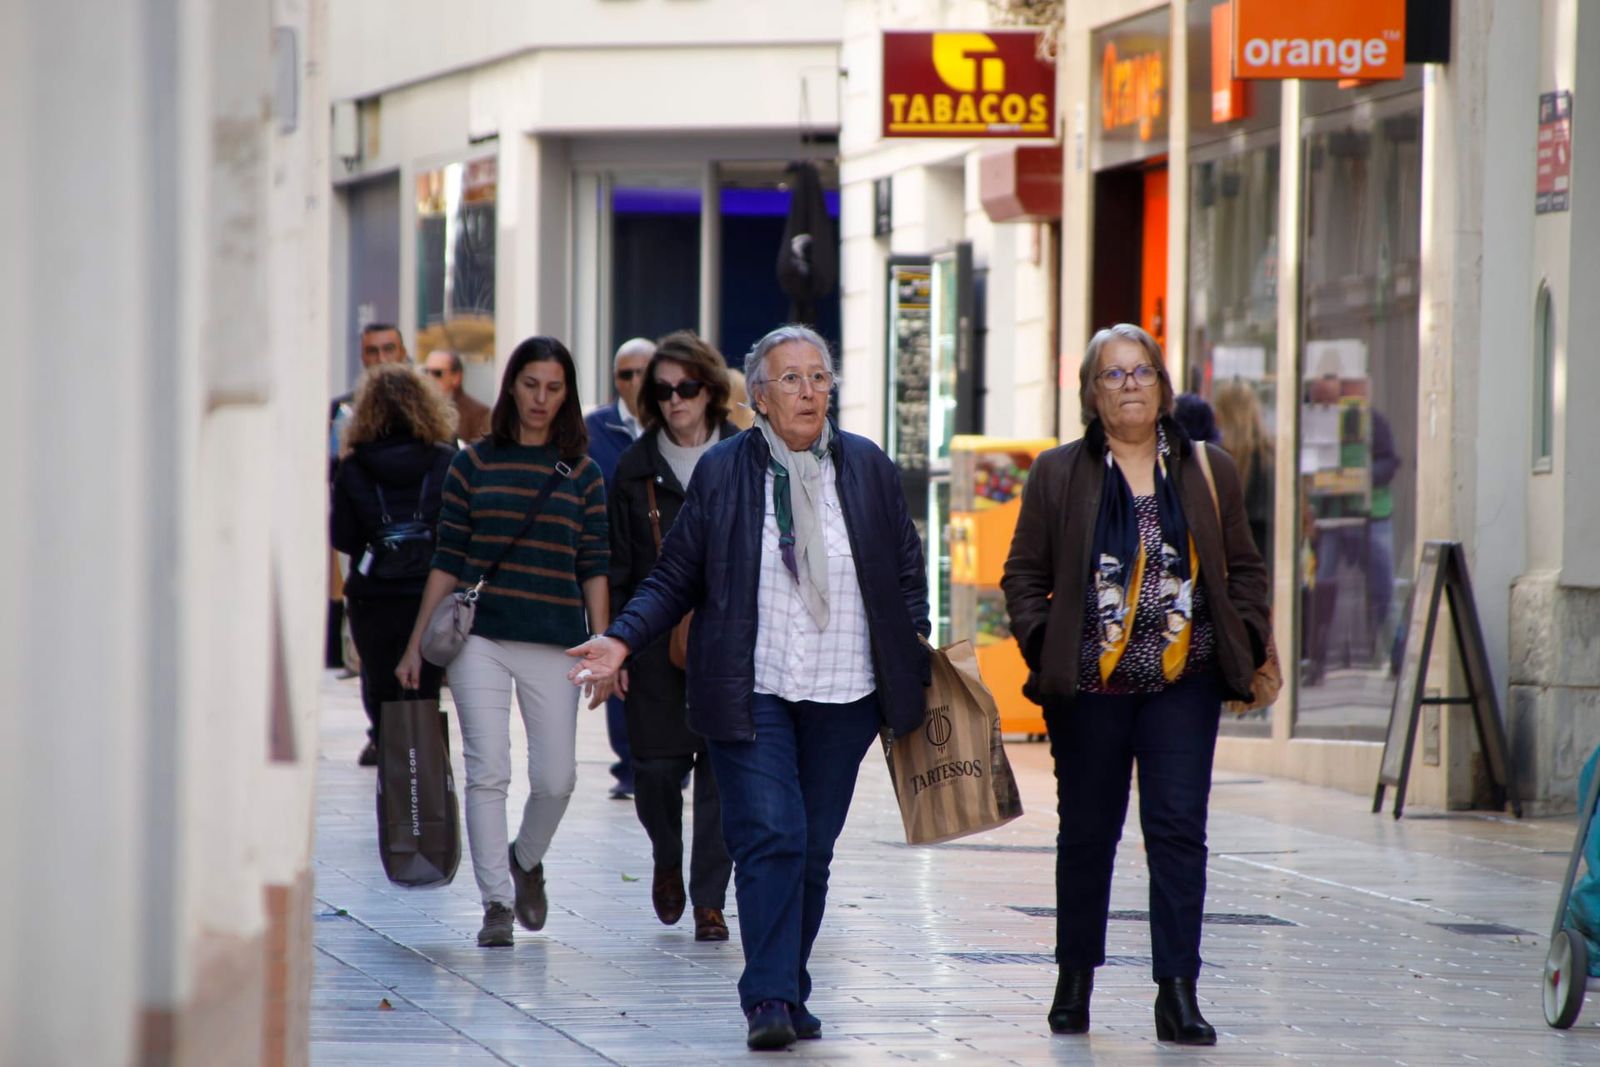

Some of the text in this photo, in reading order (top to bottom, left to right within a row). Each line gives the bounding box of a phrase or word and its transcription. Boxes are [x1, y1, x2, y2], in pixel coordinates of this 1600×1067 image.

[1245, 38, 1387, 75] orange
[888, 93, 1048, 123] TABACOS
[409, 748, 420, 836] puntroma.com
[911, 759, 983, 796] TARTESSOS
